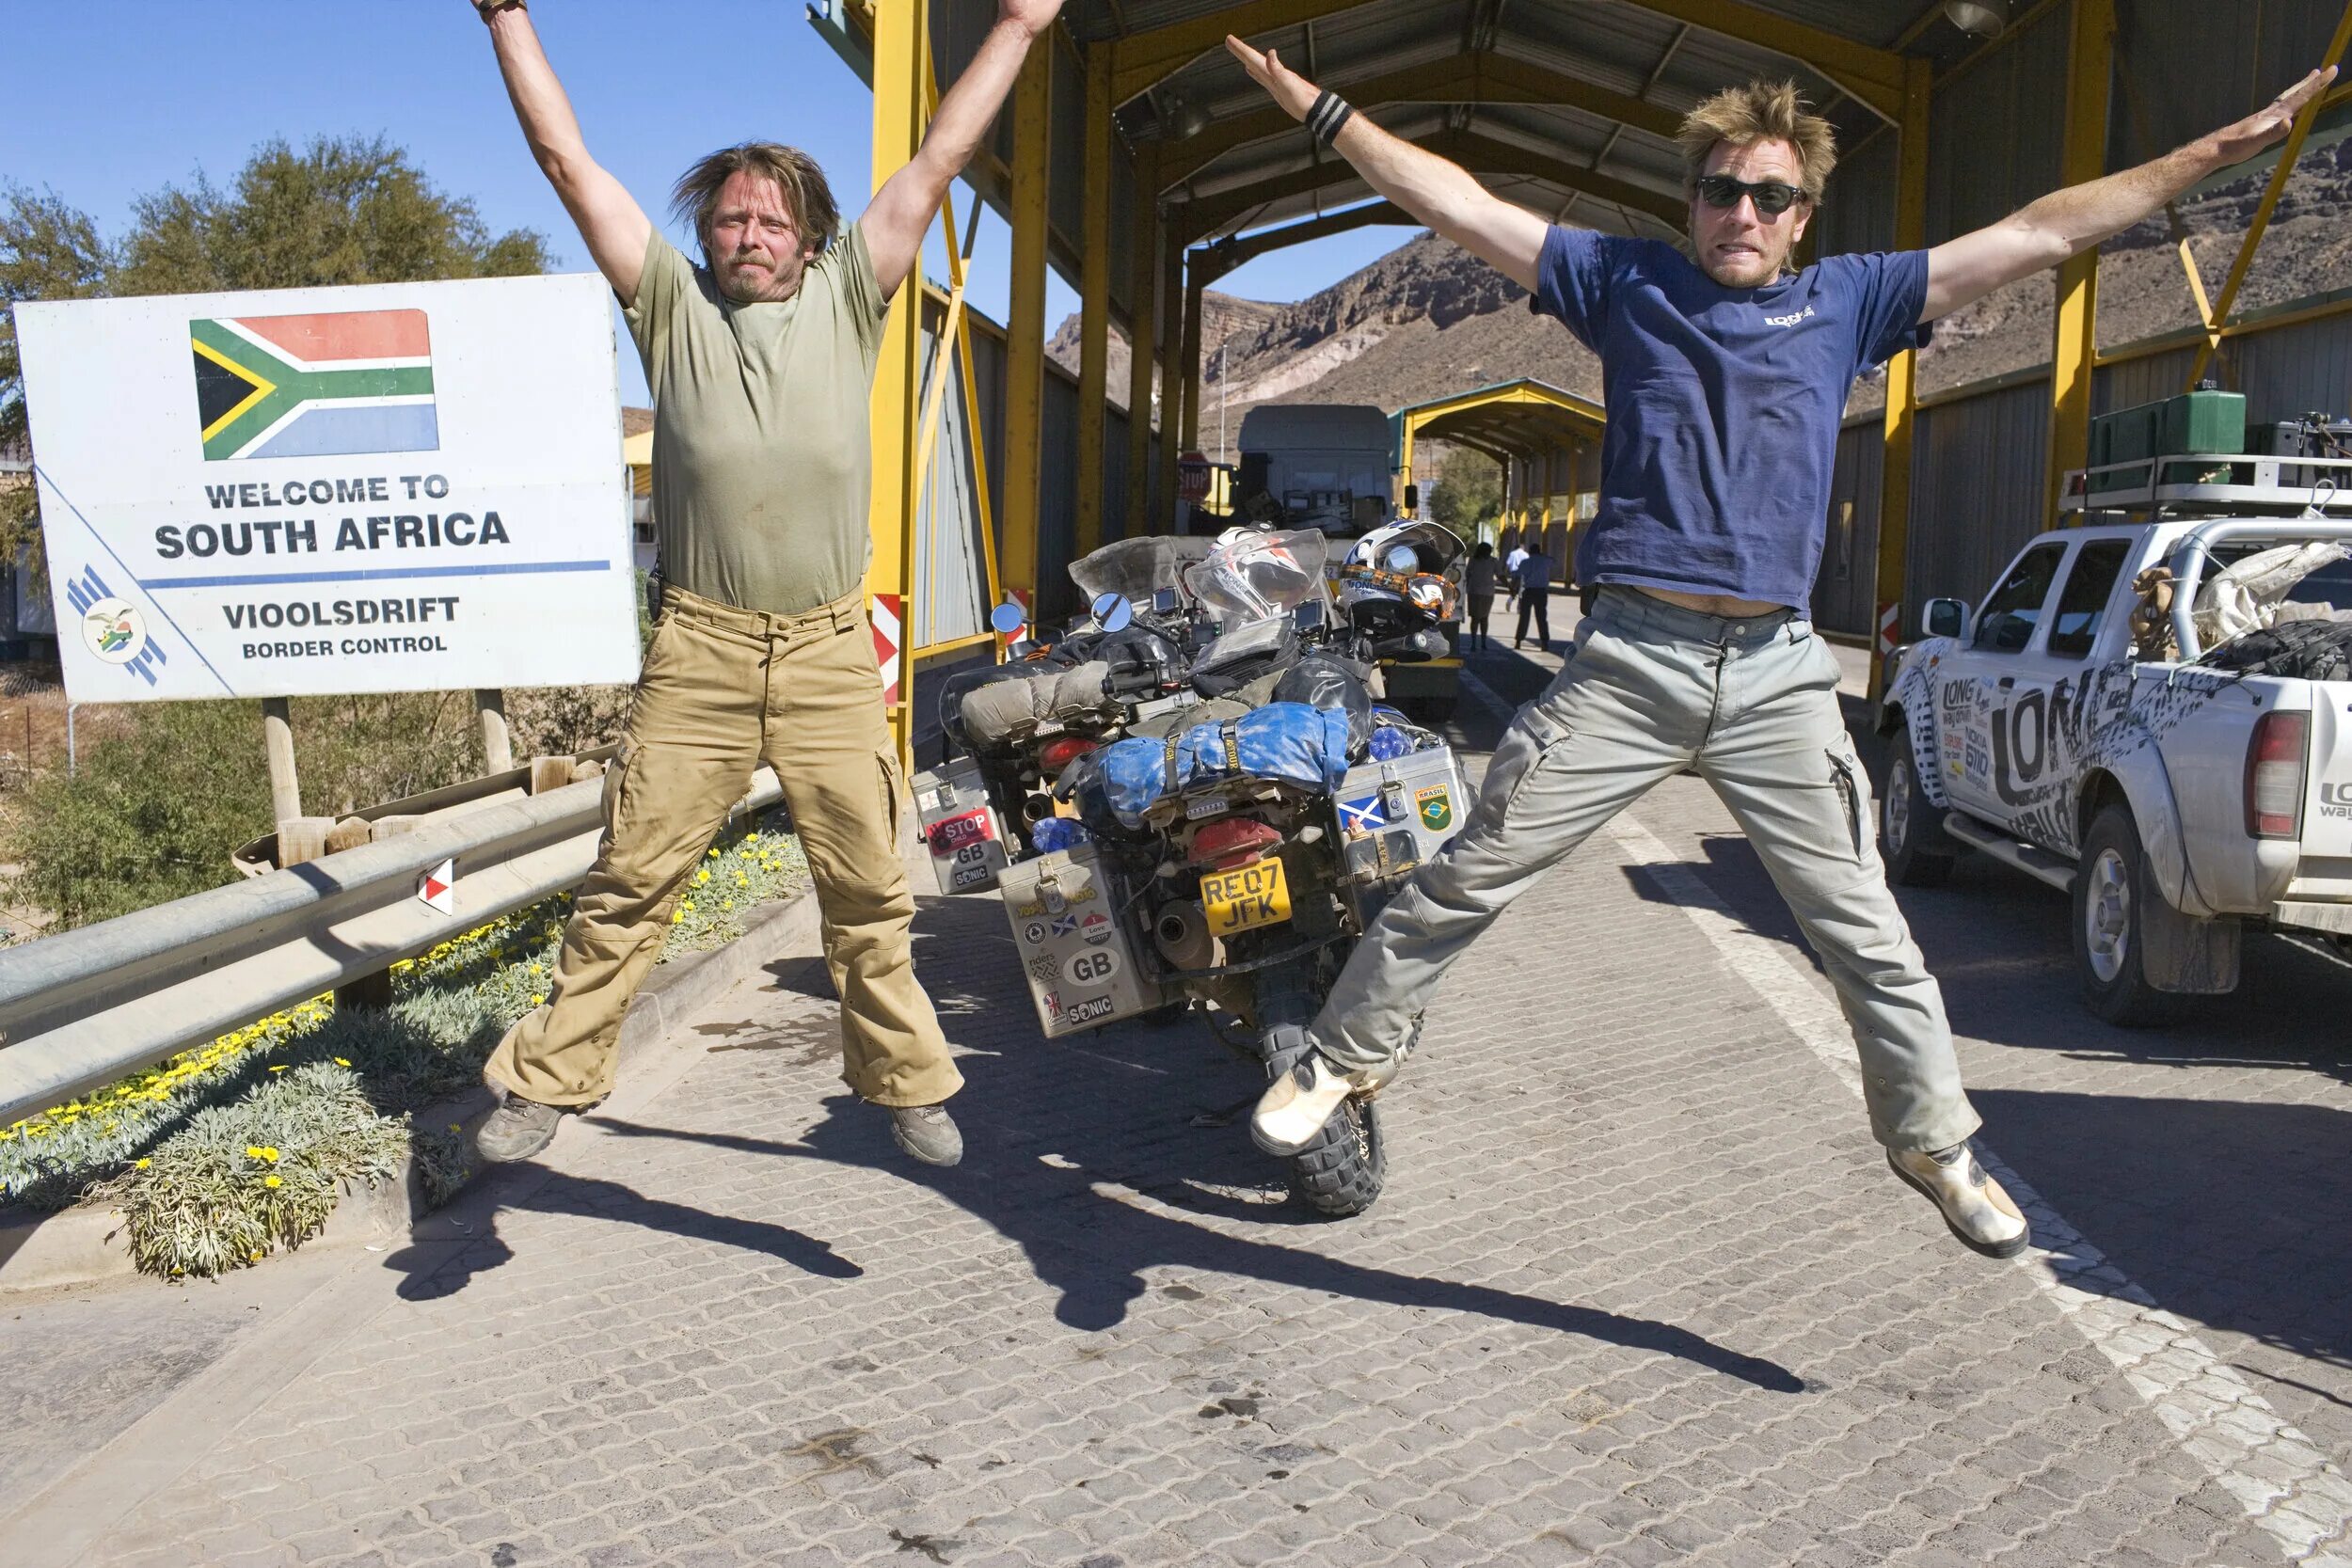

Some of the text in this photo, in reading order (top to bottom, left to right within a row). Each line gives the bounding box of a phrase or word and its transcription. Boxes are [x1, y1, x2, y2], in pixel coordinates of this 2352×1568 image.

[205, 474, 450, 509] WELCOME TO
[155, 512, 510, 560] SOUTH AFRICA
[223, 596, 459, 629] VIOOLSDRIFT
[242, 636, 448, 659] BORDER CONTROL
[1943, 677, 1977, 710] LONG
[1965, 726, 1988, 751] NOKIA
[1965, 743, 1989, 777] 6110
[1419, 788, 1444, 799] BRASIL
[946, 815, 985, 839] STOP
[951, 834, 967, 844] CHILD
[958, 843, 984, 864] GB
[956, 867, 987, 884] SONIC
[1204, 863, 1278, 905] RE07
[1223, 892, 1278, 927] JFK
[1089, 926, 1105, 934] Love
[1089, 932, 1110, 942] EGYPT
[1029, 953, 1056, 967] riders
[1073, 952, 1112, 981] GB
[1069, 998, 1112, 1022] SONIC
